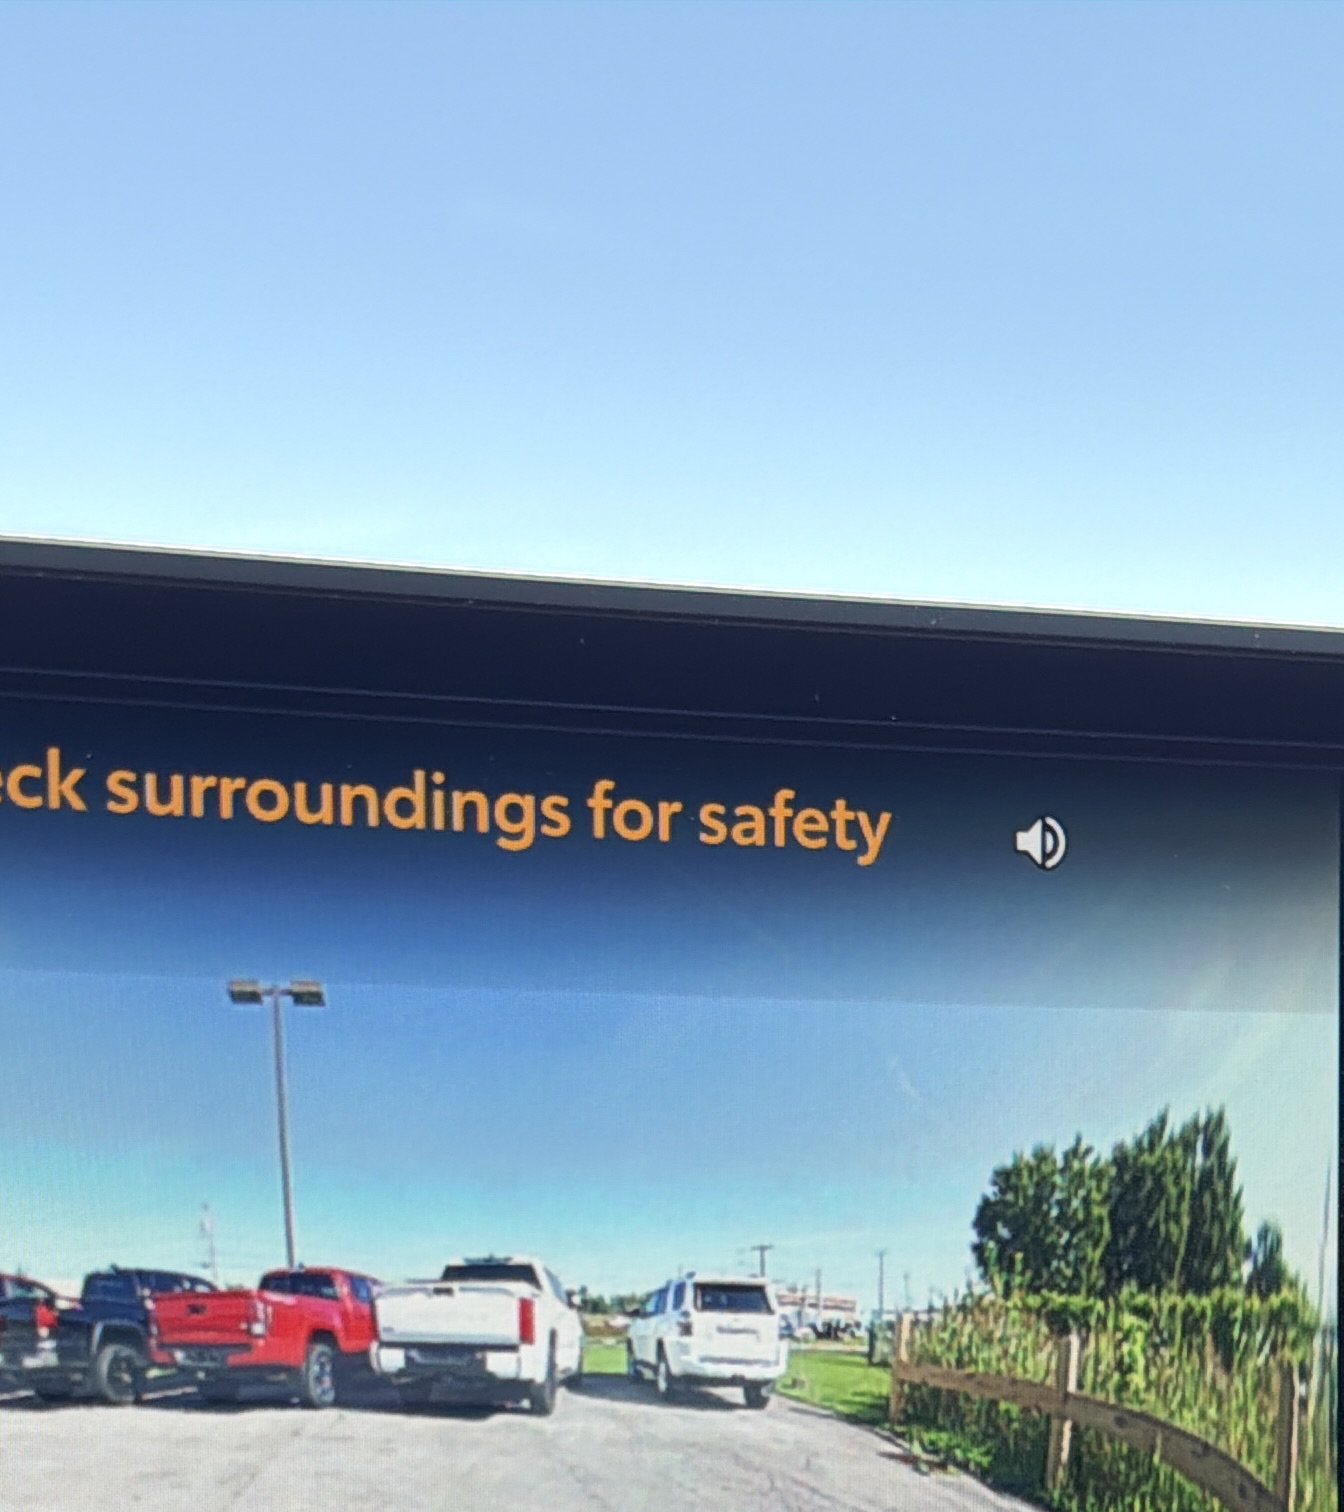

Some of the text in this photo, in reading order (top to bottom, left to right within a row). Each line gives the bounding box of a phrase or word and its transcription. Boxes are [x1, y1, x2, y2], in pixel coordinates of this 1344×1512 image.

[104, 768, 572, 852] surroundings
[586, 780, 684, 840] for
[698, 790, 893, 868] safety
